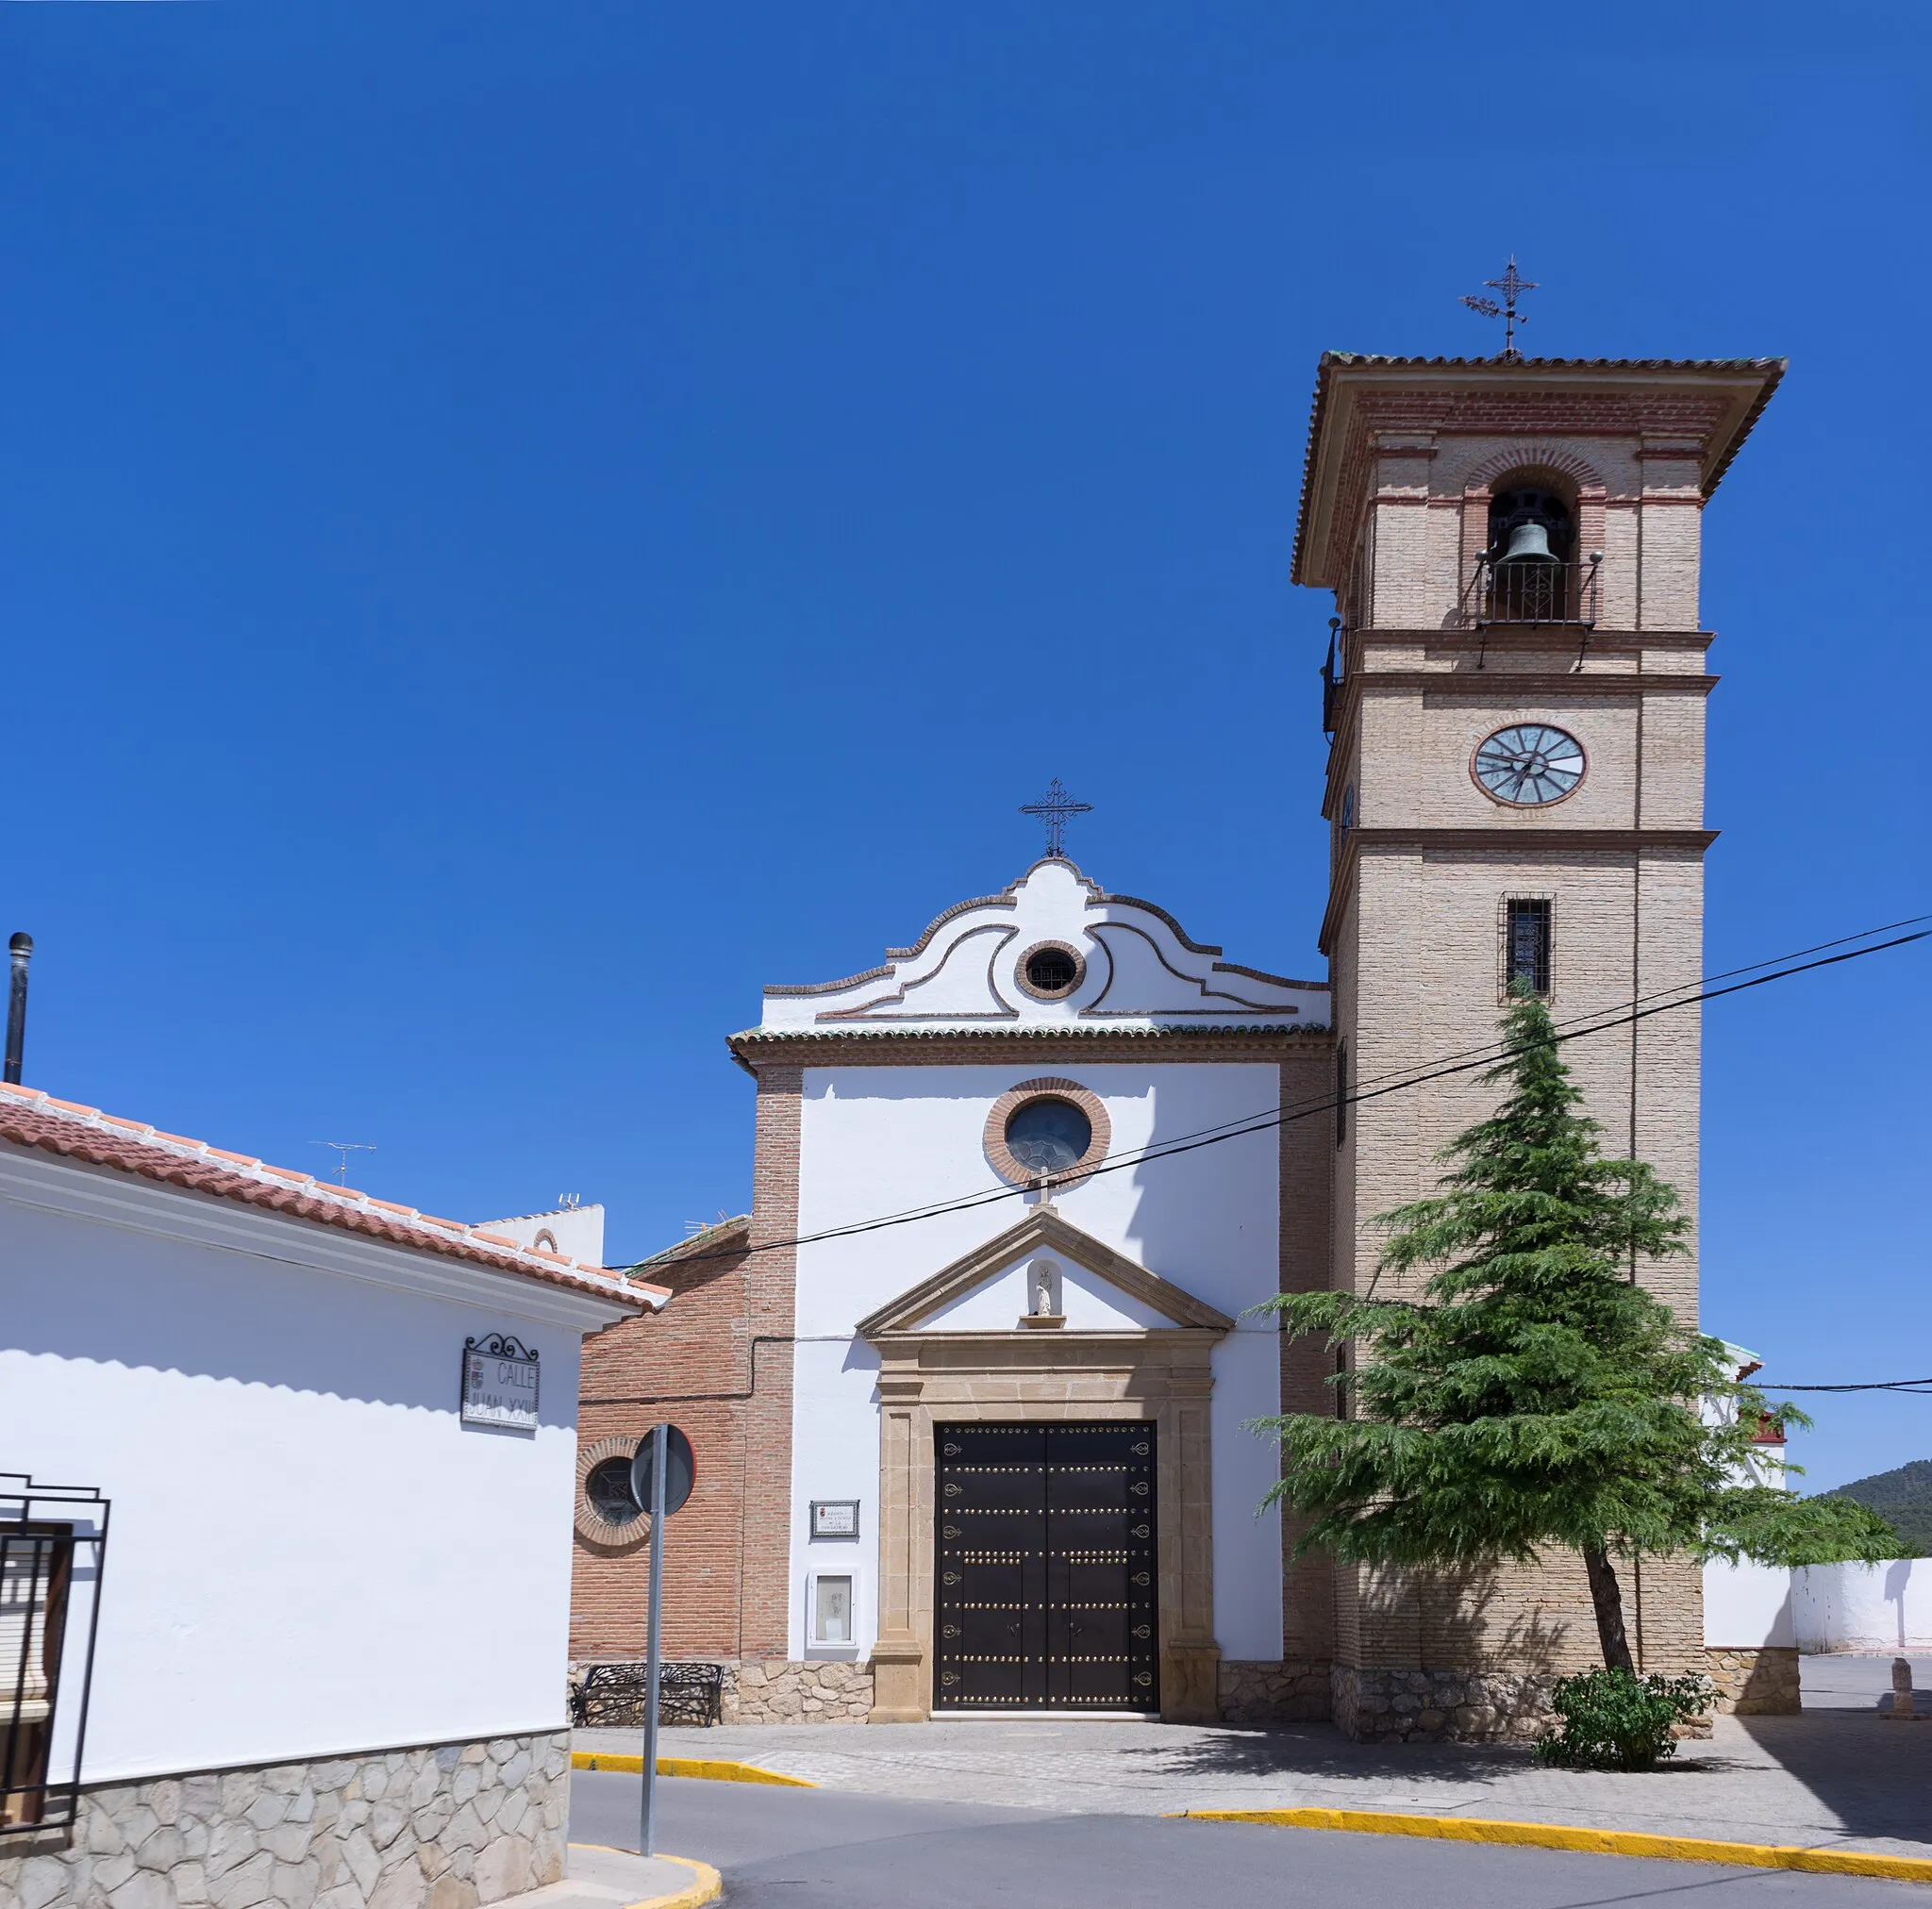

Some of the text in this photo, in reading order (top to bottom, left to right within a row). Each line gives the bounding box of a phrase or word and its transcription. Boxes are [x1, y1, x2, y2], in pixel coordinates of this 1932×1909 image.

[1524, 732, 1539, 742] 12
[498, 1362, 535, 1389] CALLE
[470, 1392, 535, 1421] JUAN XXIII
